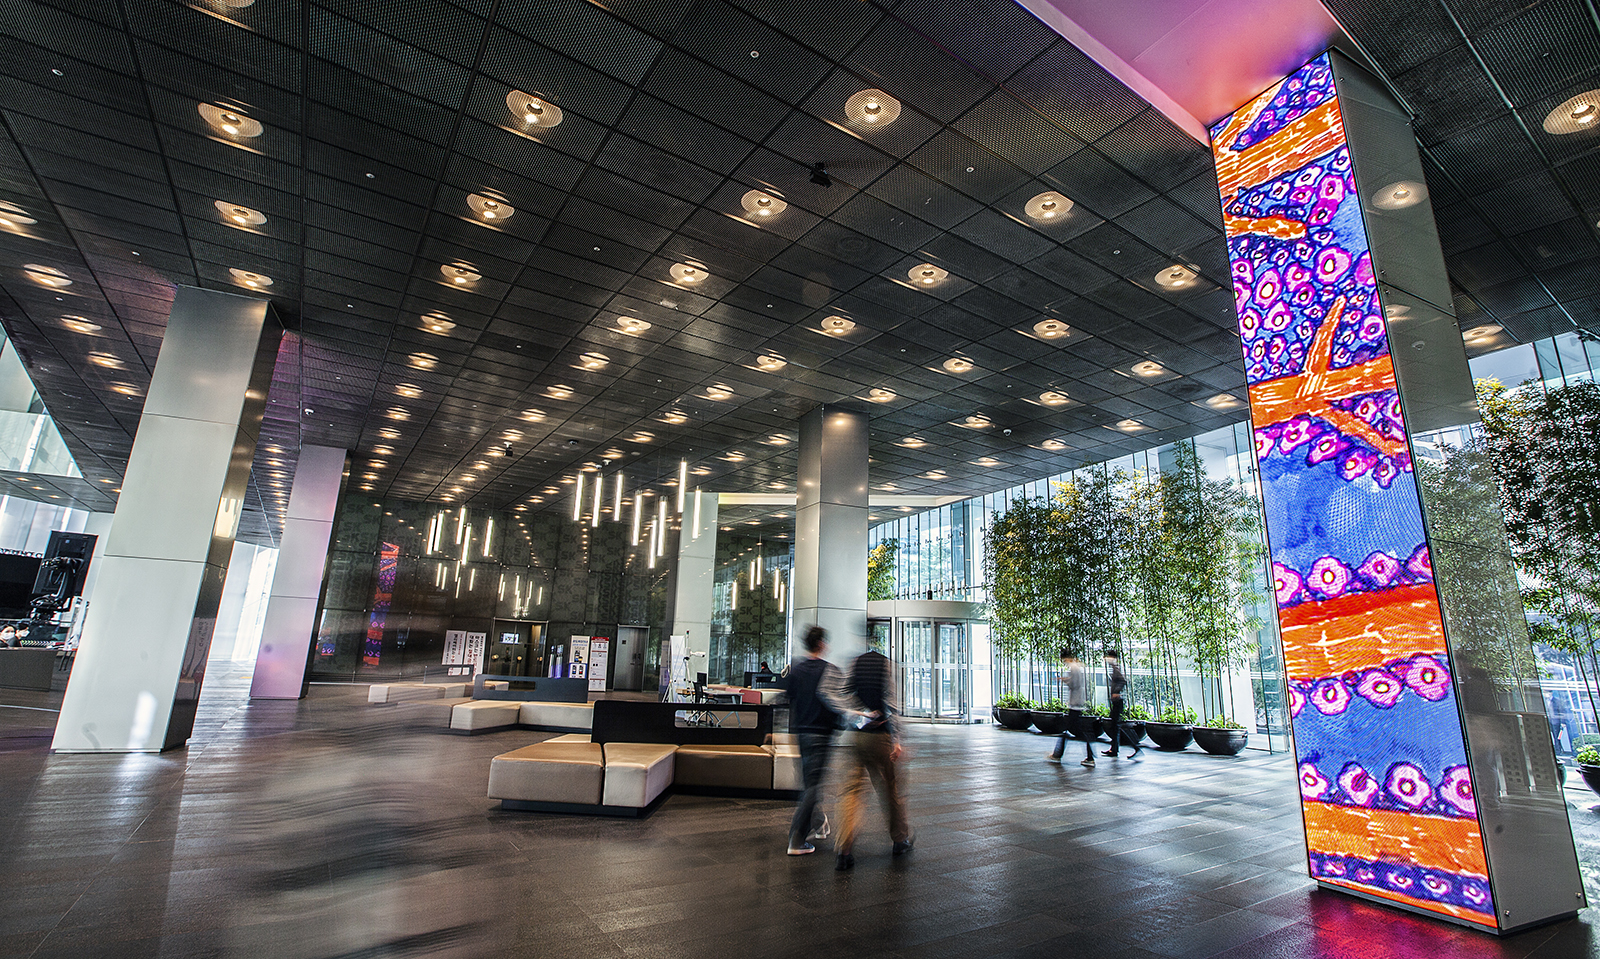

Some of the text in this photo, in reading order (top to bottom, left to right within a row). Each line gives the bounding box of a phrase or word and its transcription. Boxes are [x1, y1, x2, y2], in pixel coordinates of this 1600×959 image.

[563, 534, 577, 544] SK
[609, 531, 622, 540] SK
[593, 538, 607, 546] SK
[561, 551, 575, 560] SK
[607, 547, 620, 556] SK
[592, 554, 605, 563] SK
[740, 591, 753, 600] SK
[740, 607, 752, 615] SK
[766, 608, 778, 616] SK
